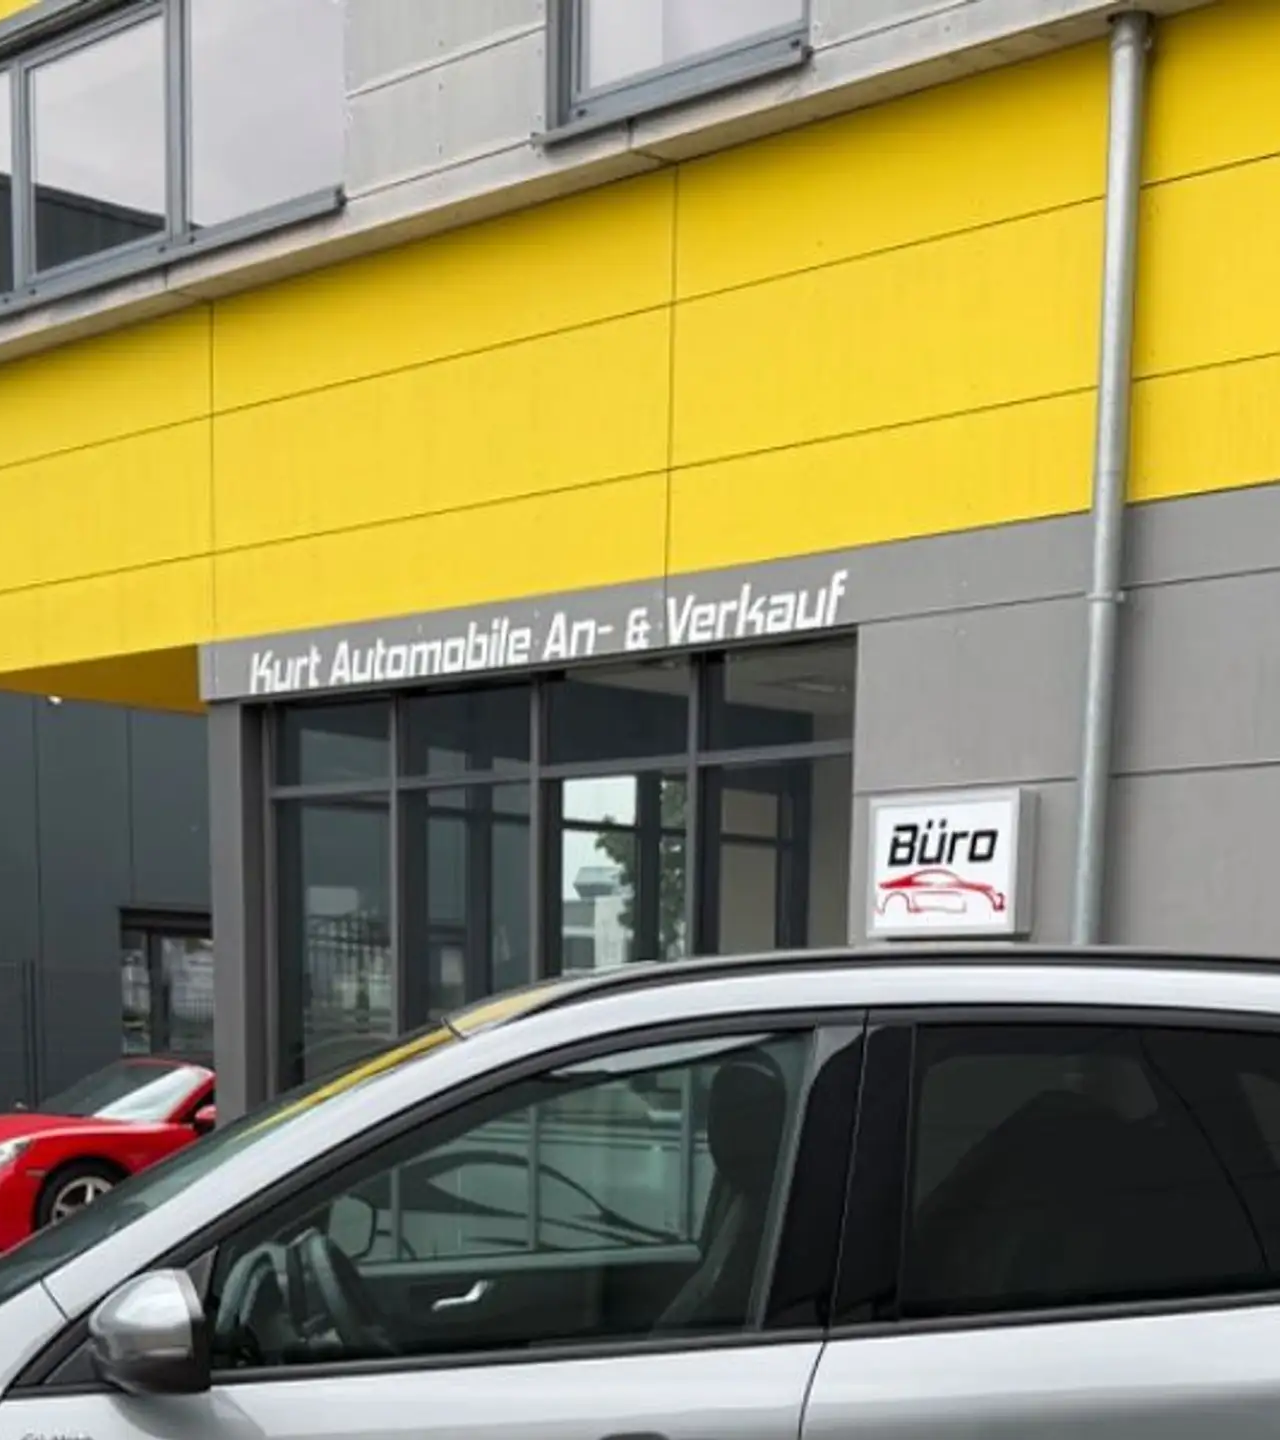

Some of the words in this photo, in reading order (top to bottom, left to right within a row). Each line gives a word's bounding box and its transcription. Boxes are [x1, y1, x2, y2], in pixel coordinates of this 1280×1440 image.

[249, 643, 322, 695] Kurt
[329, 617, 532, 687] Automobile
[541, 609, 615, 662] An-
[624, 605, 652, 651] &
[666, 568, 849, 647] Verkauf
[887, 818, 999, 867] Büro
